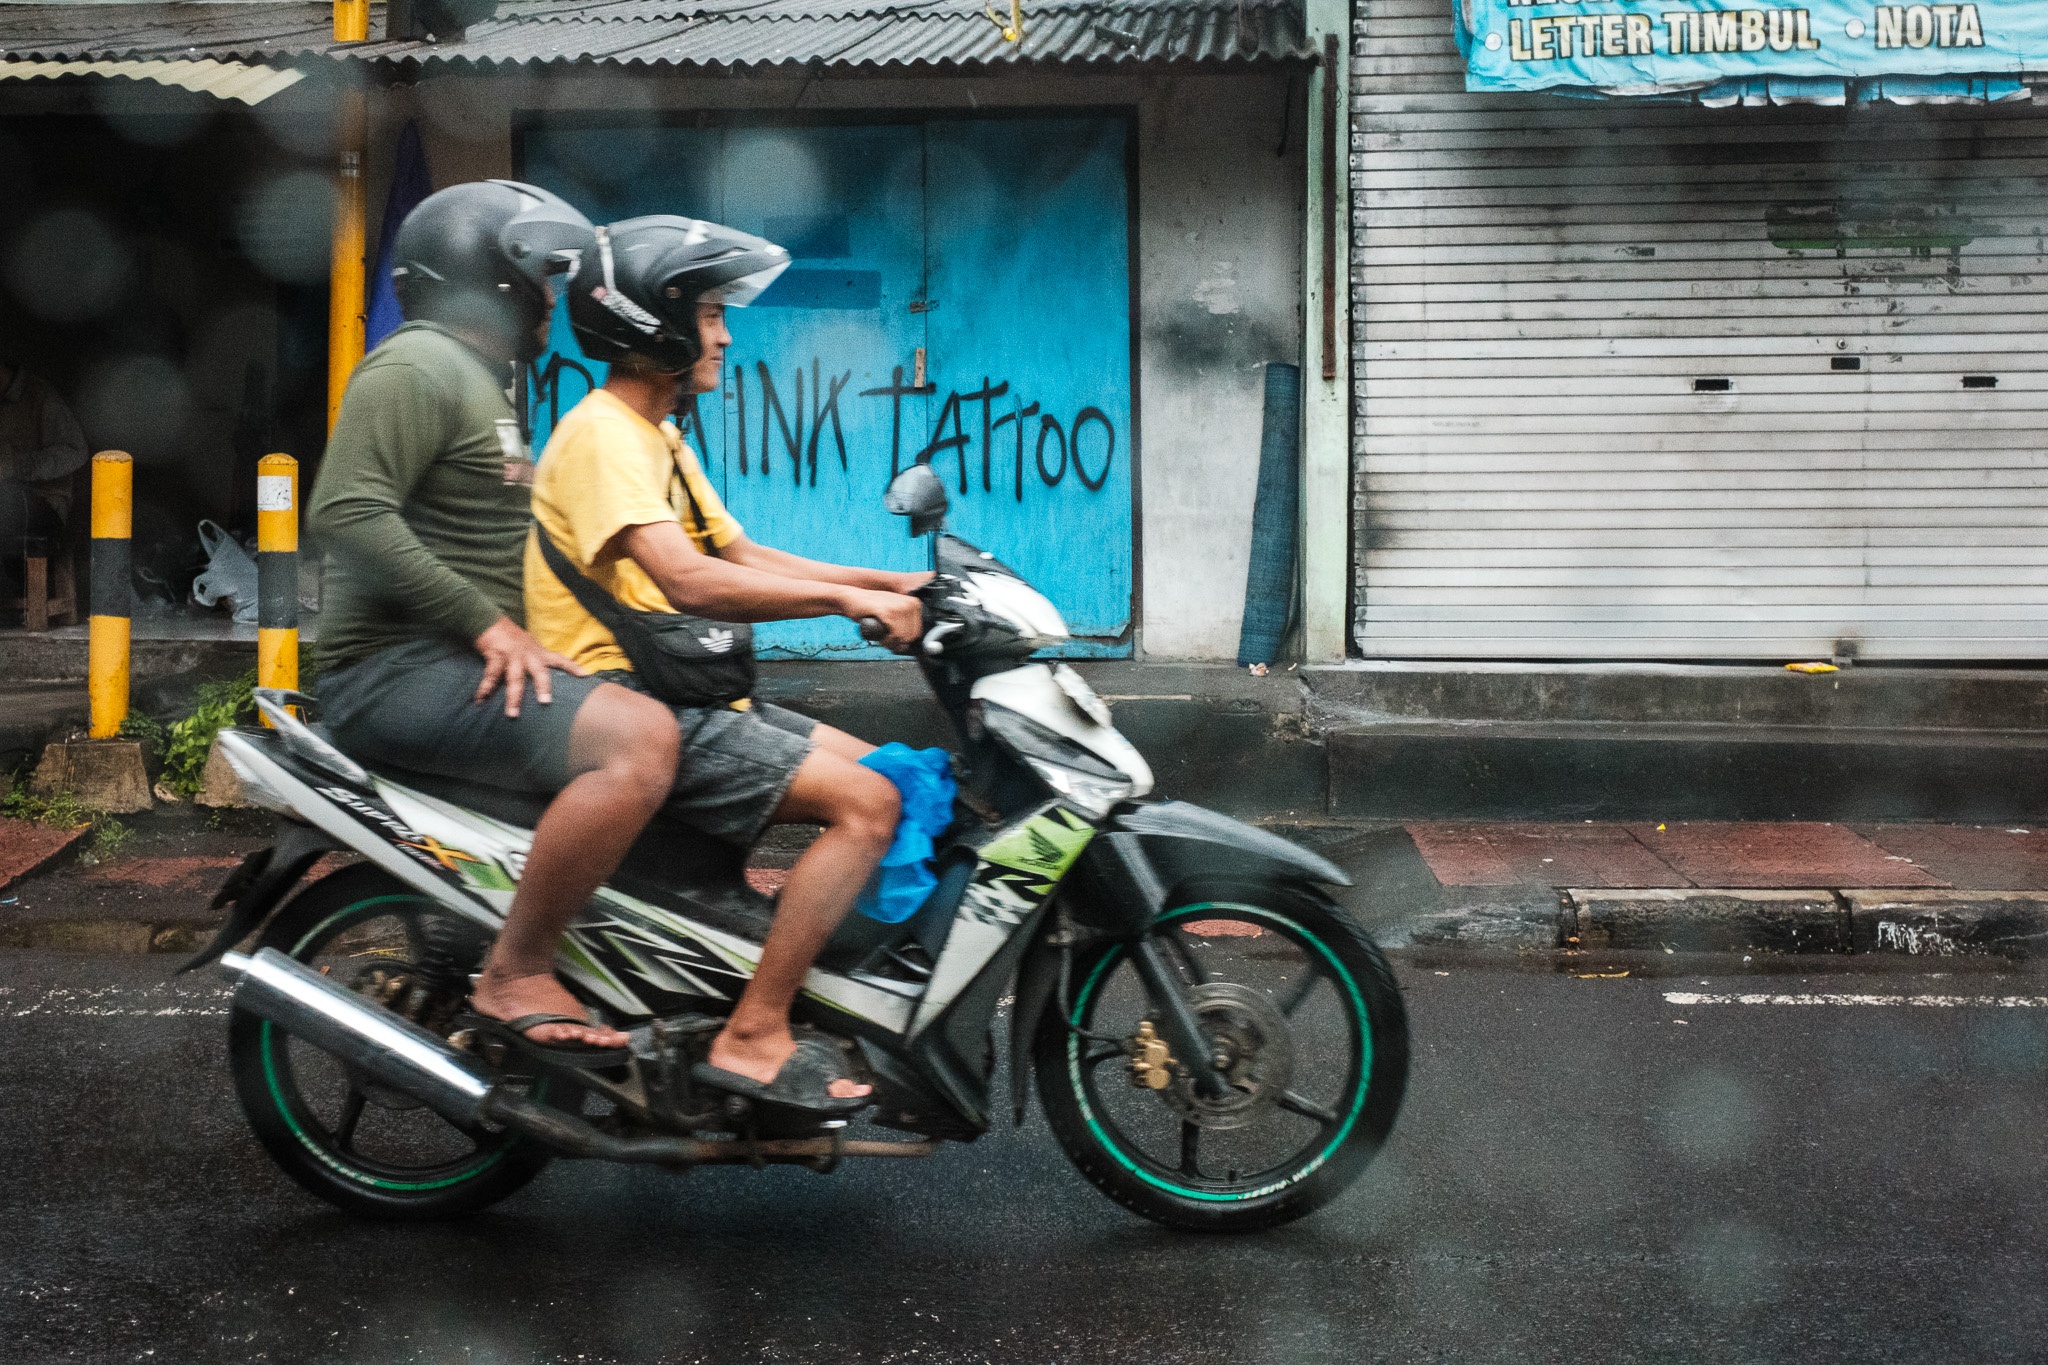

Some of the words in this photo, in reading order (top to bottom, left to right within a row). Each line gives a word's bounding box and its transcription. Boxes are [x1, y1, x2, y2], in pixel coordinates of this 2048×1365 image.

[1509, 13, 1655, 62] LETTER
[1661, 9, 1821, 56] TIMBUL
[1874, 4, 1986, 50] NOTA
[859, 364, 1115, 503] TATTOO
